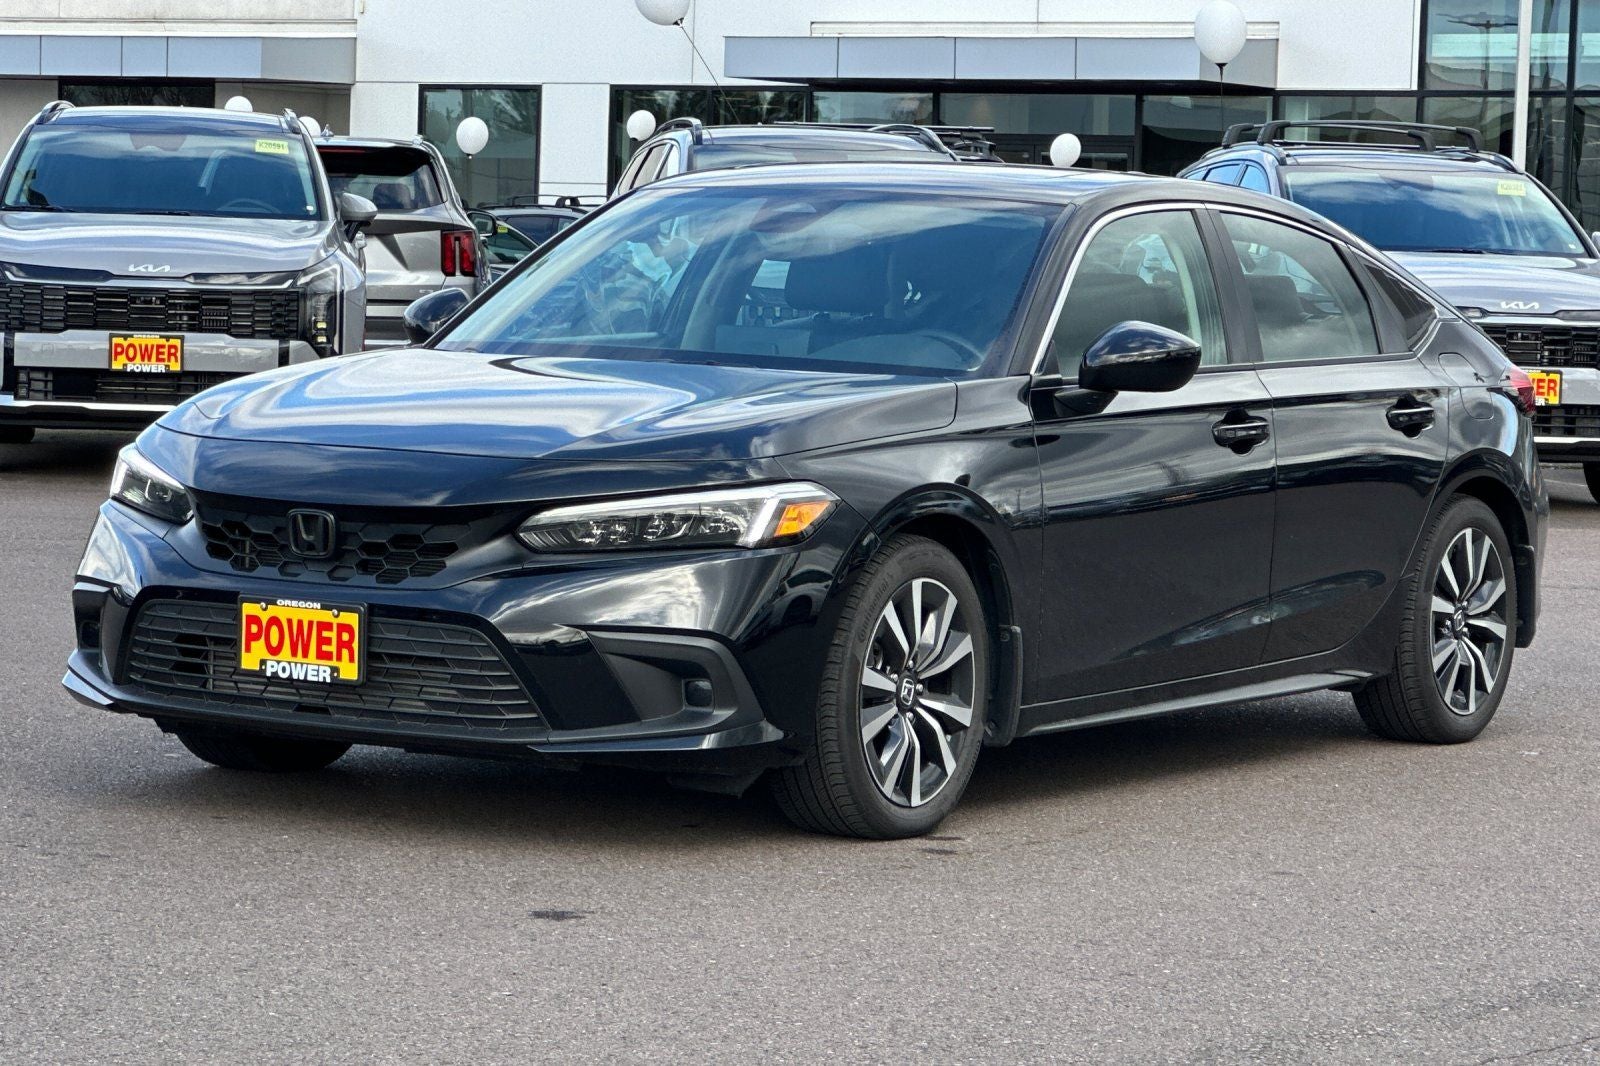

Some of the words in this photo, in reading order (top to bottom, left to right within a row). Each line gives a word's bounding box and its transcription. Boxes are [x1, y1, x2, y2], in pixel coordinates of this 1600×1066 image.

[113, 342, 179, 363] POWER
[126, 363, 166, 373] POWER
[276, 599, 321, 610] OREGON
[244, 613, 356, 664] POWER
[265, 660, 332, 683] POWER
